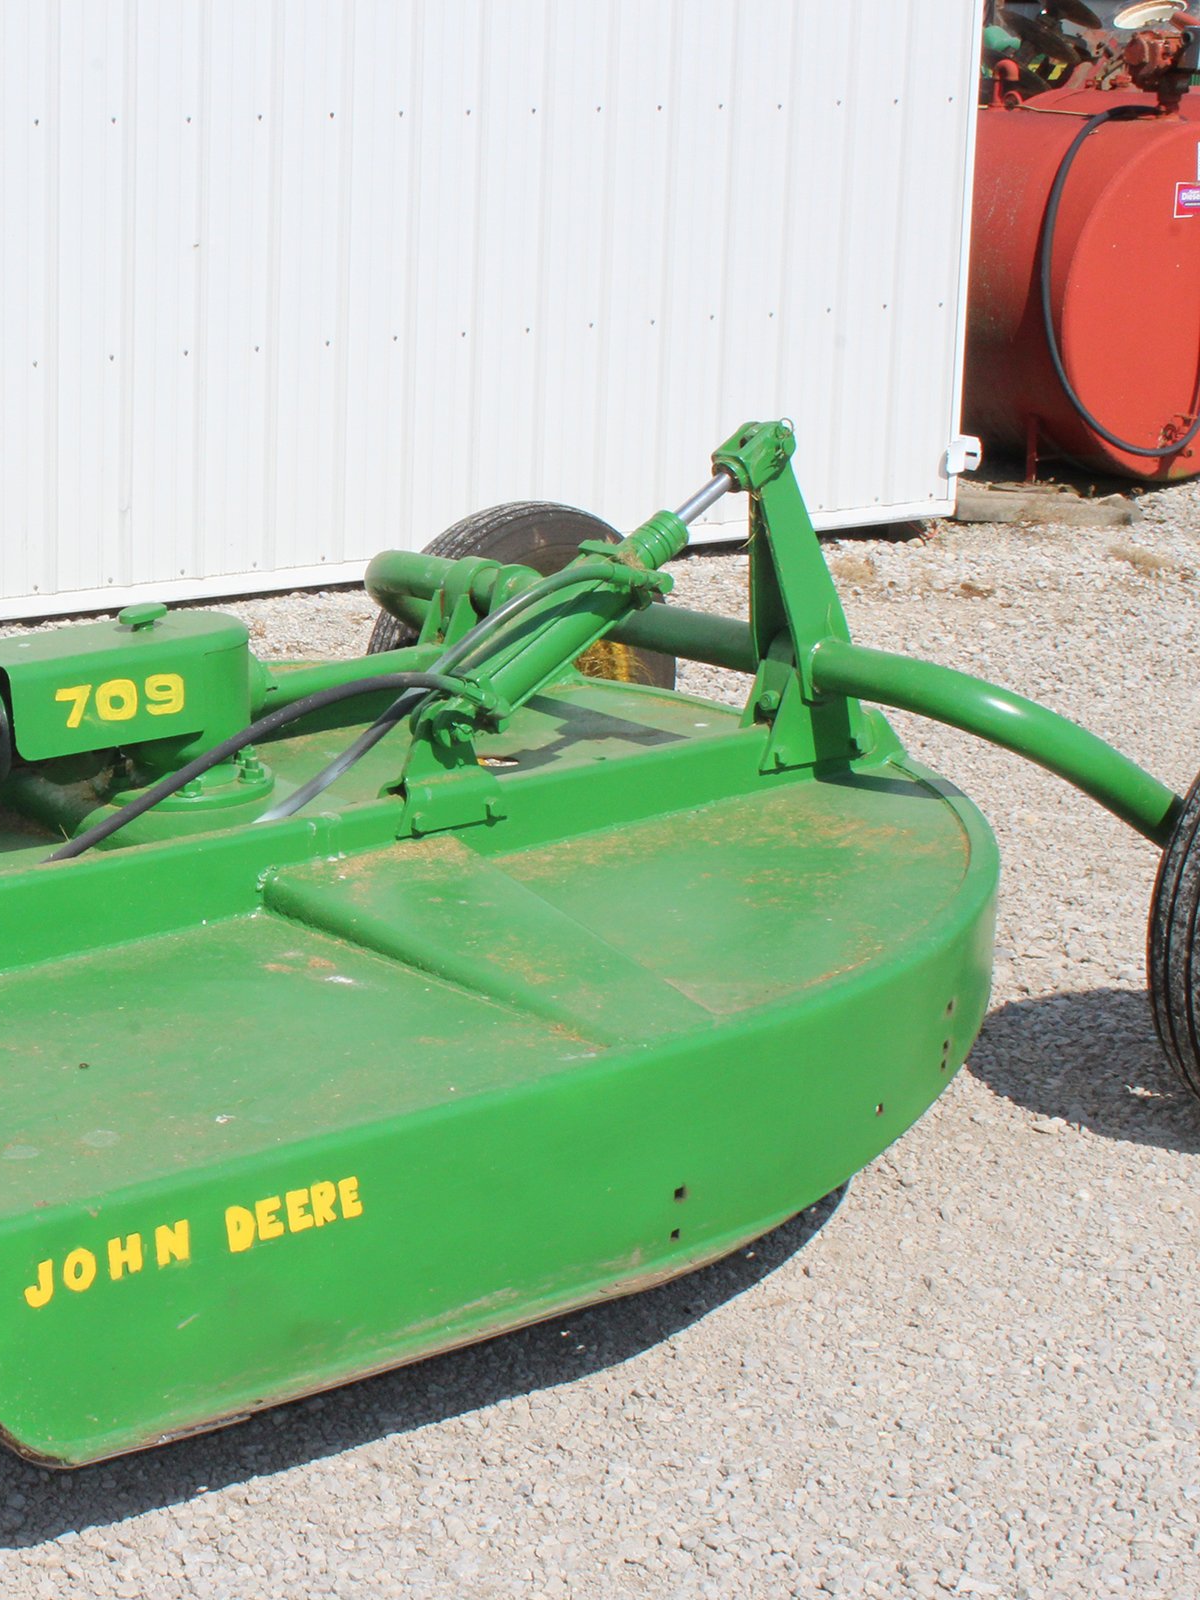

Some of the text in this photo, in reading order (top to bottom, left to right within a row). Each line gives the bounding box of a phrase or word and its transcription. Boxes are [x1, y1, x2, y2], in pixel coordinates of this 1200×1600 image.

[55, 673, 185, 729] 709
[24, 1176, 363, 1308] JOHN DEERE
